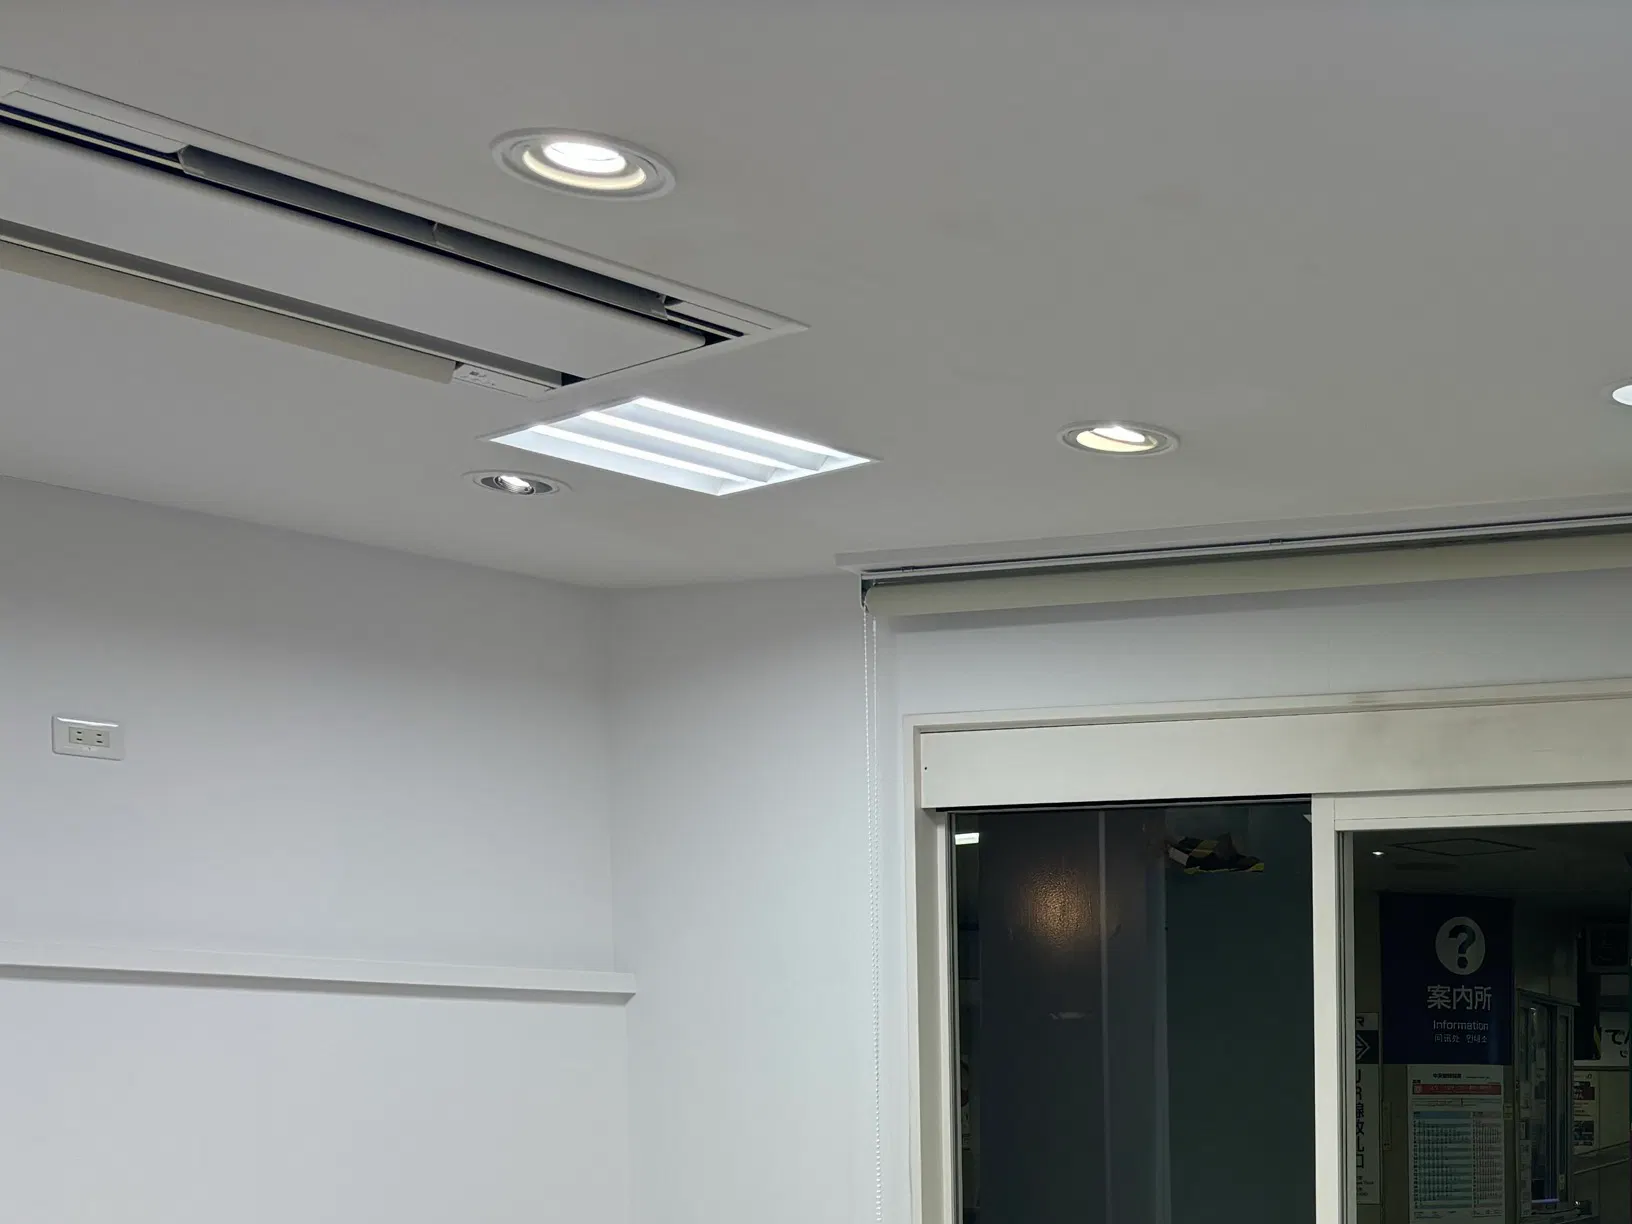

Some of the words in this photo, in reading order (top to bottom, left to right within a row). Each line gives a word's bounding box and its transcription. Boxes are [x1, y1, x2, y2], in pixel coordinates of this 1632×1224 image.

[1426, 984, 1493, 1011] 案内所
[1433, 1020, 1489, 1031] Information
